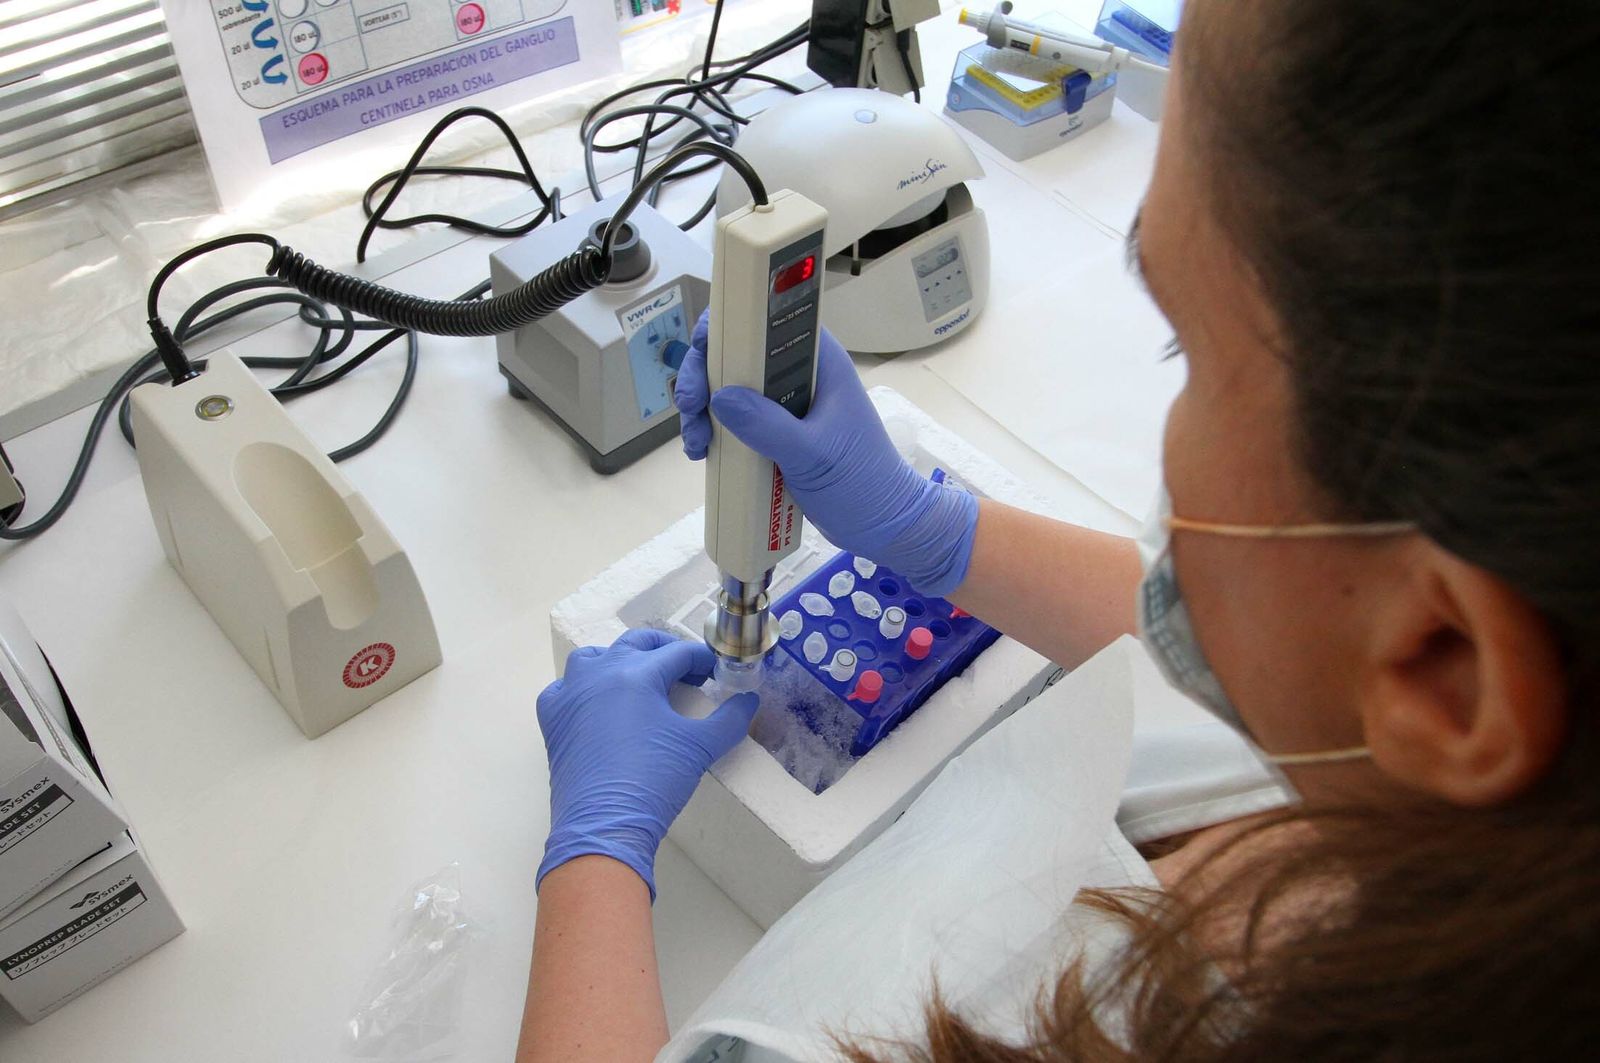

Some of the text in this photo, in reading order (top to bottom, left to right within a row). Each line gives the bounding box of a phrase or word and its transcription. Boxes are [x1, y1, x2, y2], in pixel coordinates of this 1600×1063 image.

[218, 7, 234, 19] 500
[231, 45, 242, 55] 20
[241, 81, 252, 91] 20
[282, 98, 340, 128] ESQUEMA
[342, 86, 375, 106] PARA
[377, 79, 394, 94] LA
[480, 46, 503, 62] DEL
[505, 29, 556, 53] GANGLIO
[360, 72, 494, 124] CENTINELA PARA OSNA
[802, 256, 815, 280] 3
[627, 304, 653, 322] VWR
[934, 308, 970, 335] eppendorf
[771, 479, 784, 541] POLYTRON
[21, 802, 40, 818] SET
[7, 897, 121, 966] LYNOPREP BLADE SET
